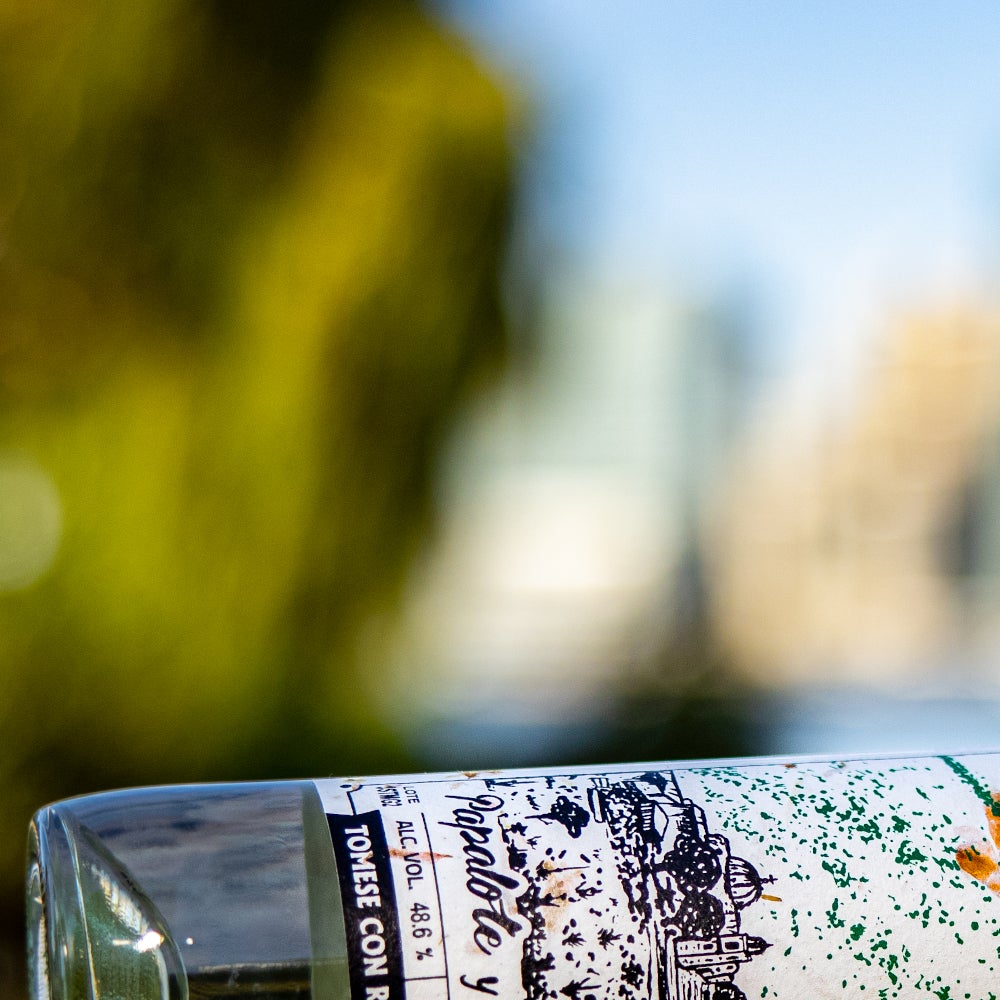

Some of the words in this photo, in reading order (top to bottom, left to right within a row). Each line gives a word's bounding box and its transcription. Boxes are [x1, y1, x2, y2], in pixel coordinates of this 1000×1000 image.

[402, 785, 421, 804] LOTE
[395, 820, 418, 850] ALC.
[344, 824, 382, 909] TOMESE
[403, 852, 424, 891] VOL.
[437, 794, 523, 956] Papalote
[410, 902, 433, 939] 48.6
[359, 916, 388, 977] CON
[415, 947, 434, 961] %
[459, 974, 499, 996] y
